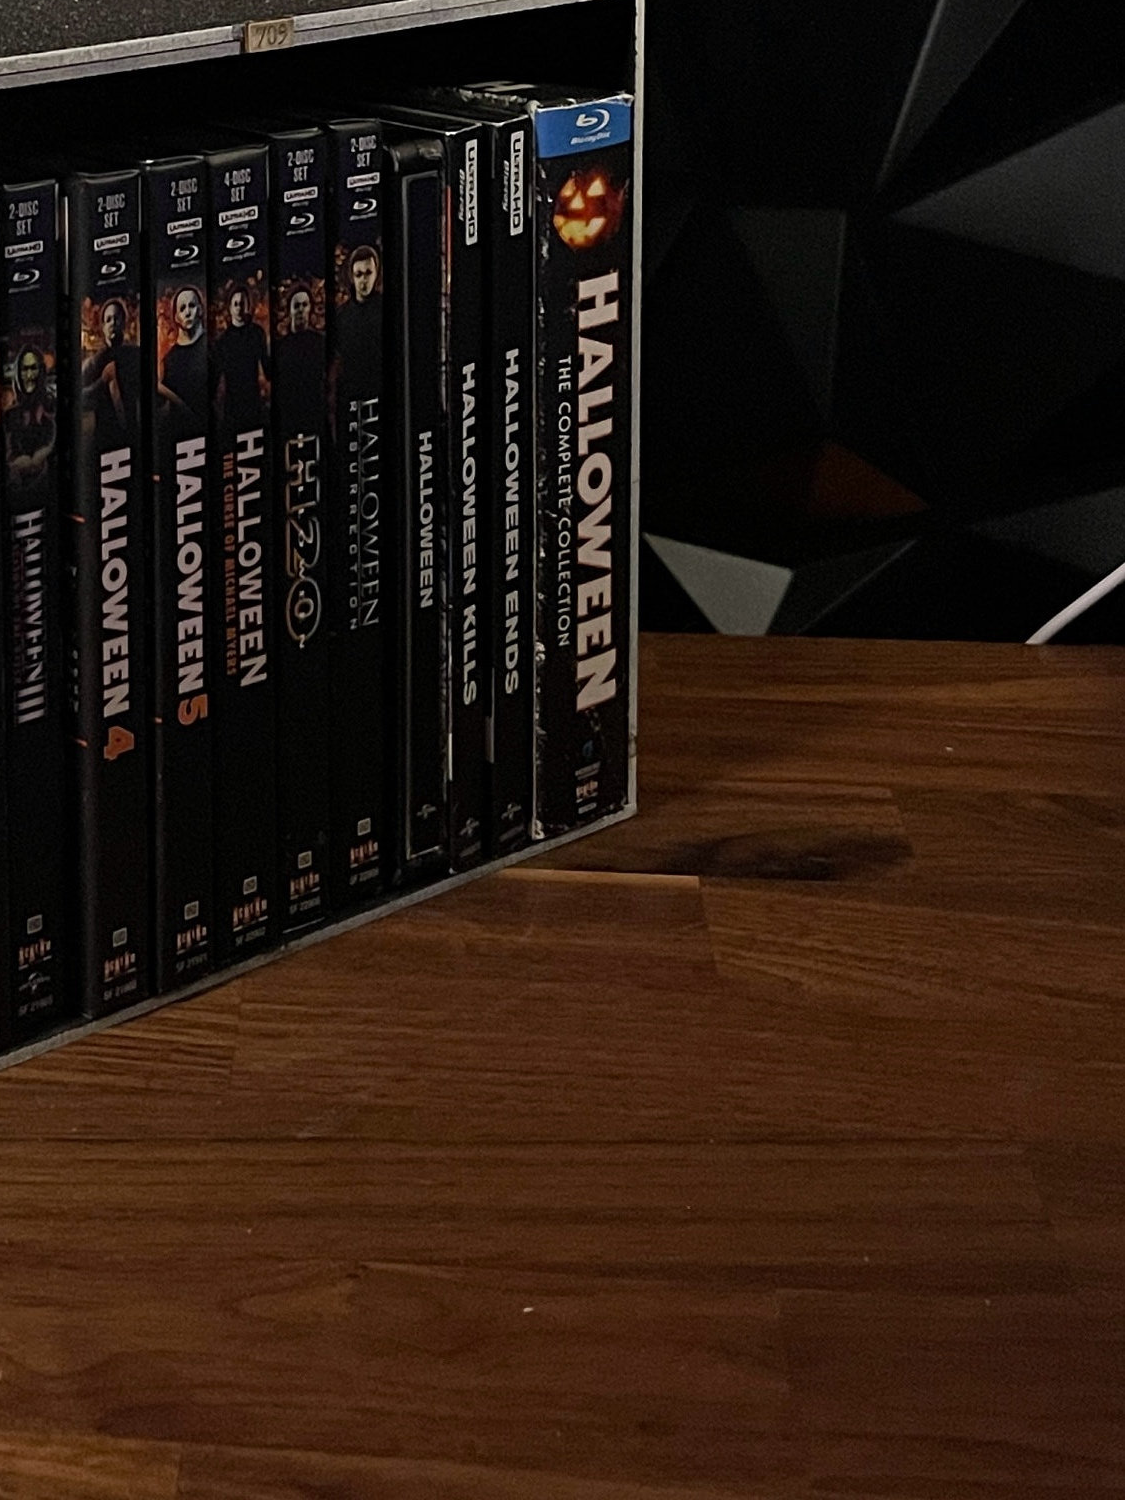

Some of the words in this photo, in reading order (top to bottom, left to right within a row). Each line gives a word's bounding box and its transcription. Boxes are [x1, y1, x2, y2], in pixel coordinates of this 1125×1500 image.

[255, 24, 289, 47] 709
[176, 196, 192, 212] SET
[230, 186, 246, 203] SET
[293, 166, 309, 183] SET
[356, 152, 371, 168] SET
[16, 219, 32, 236] SET
[104, 212, 119, 228] SET
[558, 355, 571, 393] THE
[222, 452, 234, 479] THE
[462, 362, 476, 595] HALLOWEEN
[505, 348, 519, 581] HALLOWEEN
[558, 401, 573, 509] COMPLETE
[576, 269, 619, 712] HALLOWEEN
[237, 428, 267, 687] HALLOWEEN
[360, 397, 379, 627] HALLOWEEN
[418, 430, 433, 608] HALLOWEEN
[100, 447, 132, 718] HALLOWEEN
[176, 436, 206, 695] HALLOWEEN
[557, 517, 571, 647] COLLECTION
[463, 603, 477, 706] KILLS
[505, 590, 519, 695] ENDS
[103, 725, 135, 761] 4
[177, 693, 209, 726] 5
